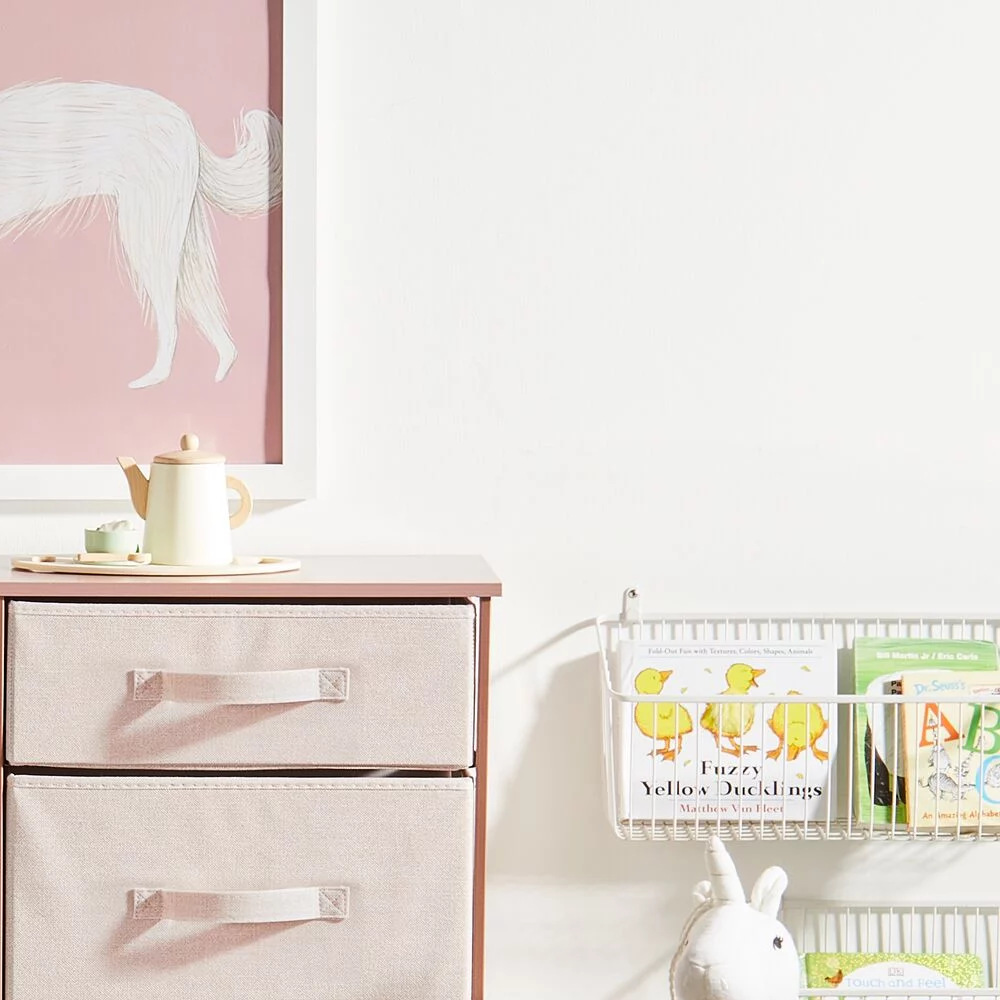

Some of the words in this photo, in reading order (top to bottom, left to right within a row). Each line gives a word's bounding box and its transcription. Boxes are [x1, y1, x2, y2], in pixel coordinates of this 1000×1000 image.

[694, 647, 708, 656] with
[914, 683, 931, 695] Dr.
[700, 760, 763, 780] Fuzzy
[640, 780, 710, 797] Yellow
[847, 978, 886, 989] Touch
[887, 978, 913, 988] and
[918, 978, 946, 989] Feel
